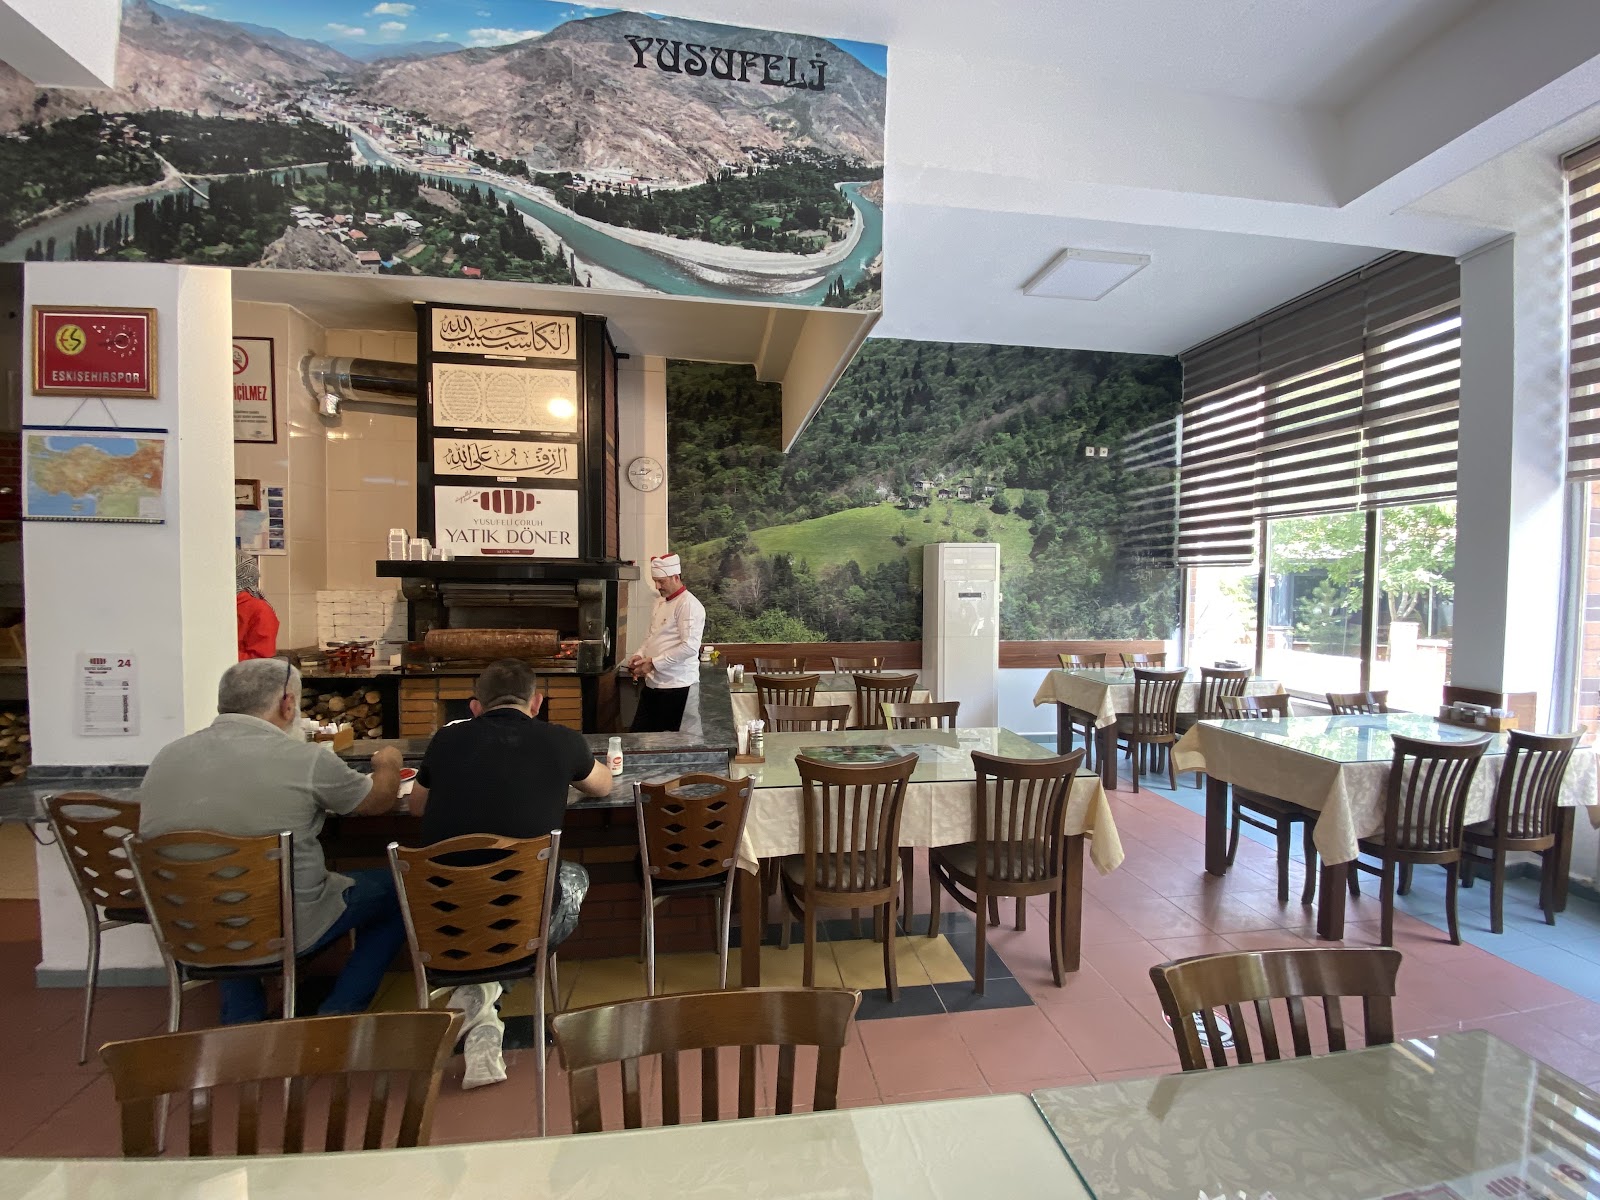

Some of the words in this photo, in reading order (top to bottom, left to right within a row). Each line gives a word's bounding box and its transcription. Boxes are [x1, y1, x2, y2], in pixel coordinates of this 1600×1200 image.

[445, 528, 500, 543] YATIK
[507, 527, 571, 545] DÖNER
[117, 659, 132, 668] 24
